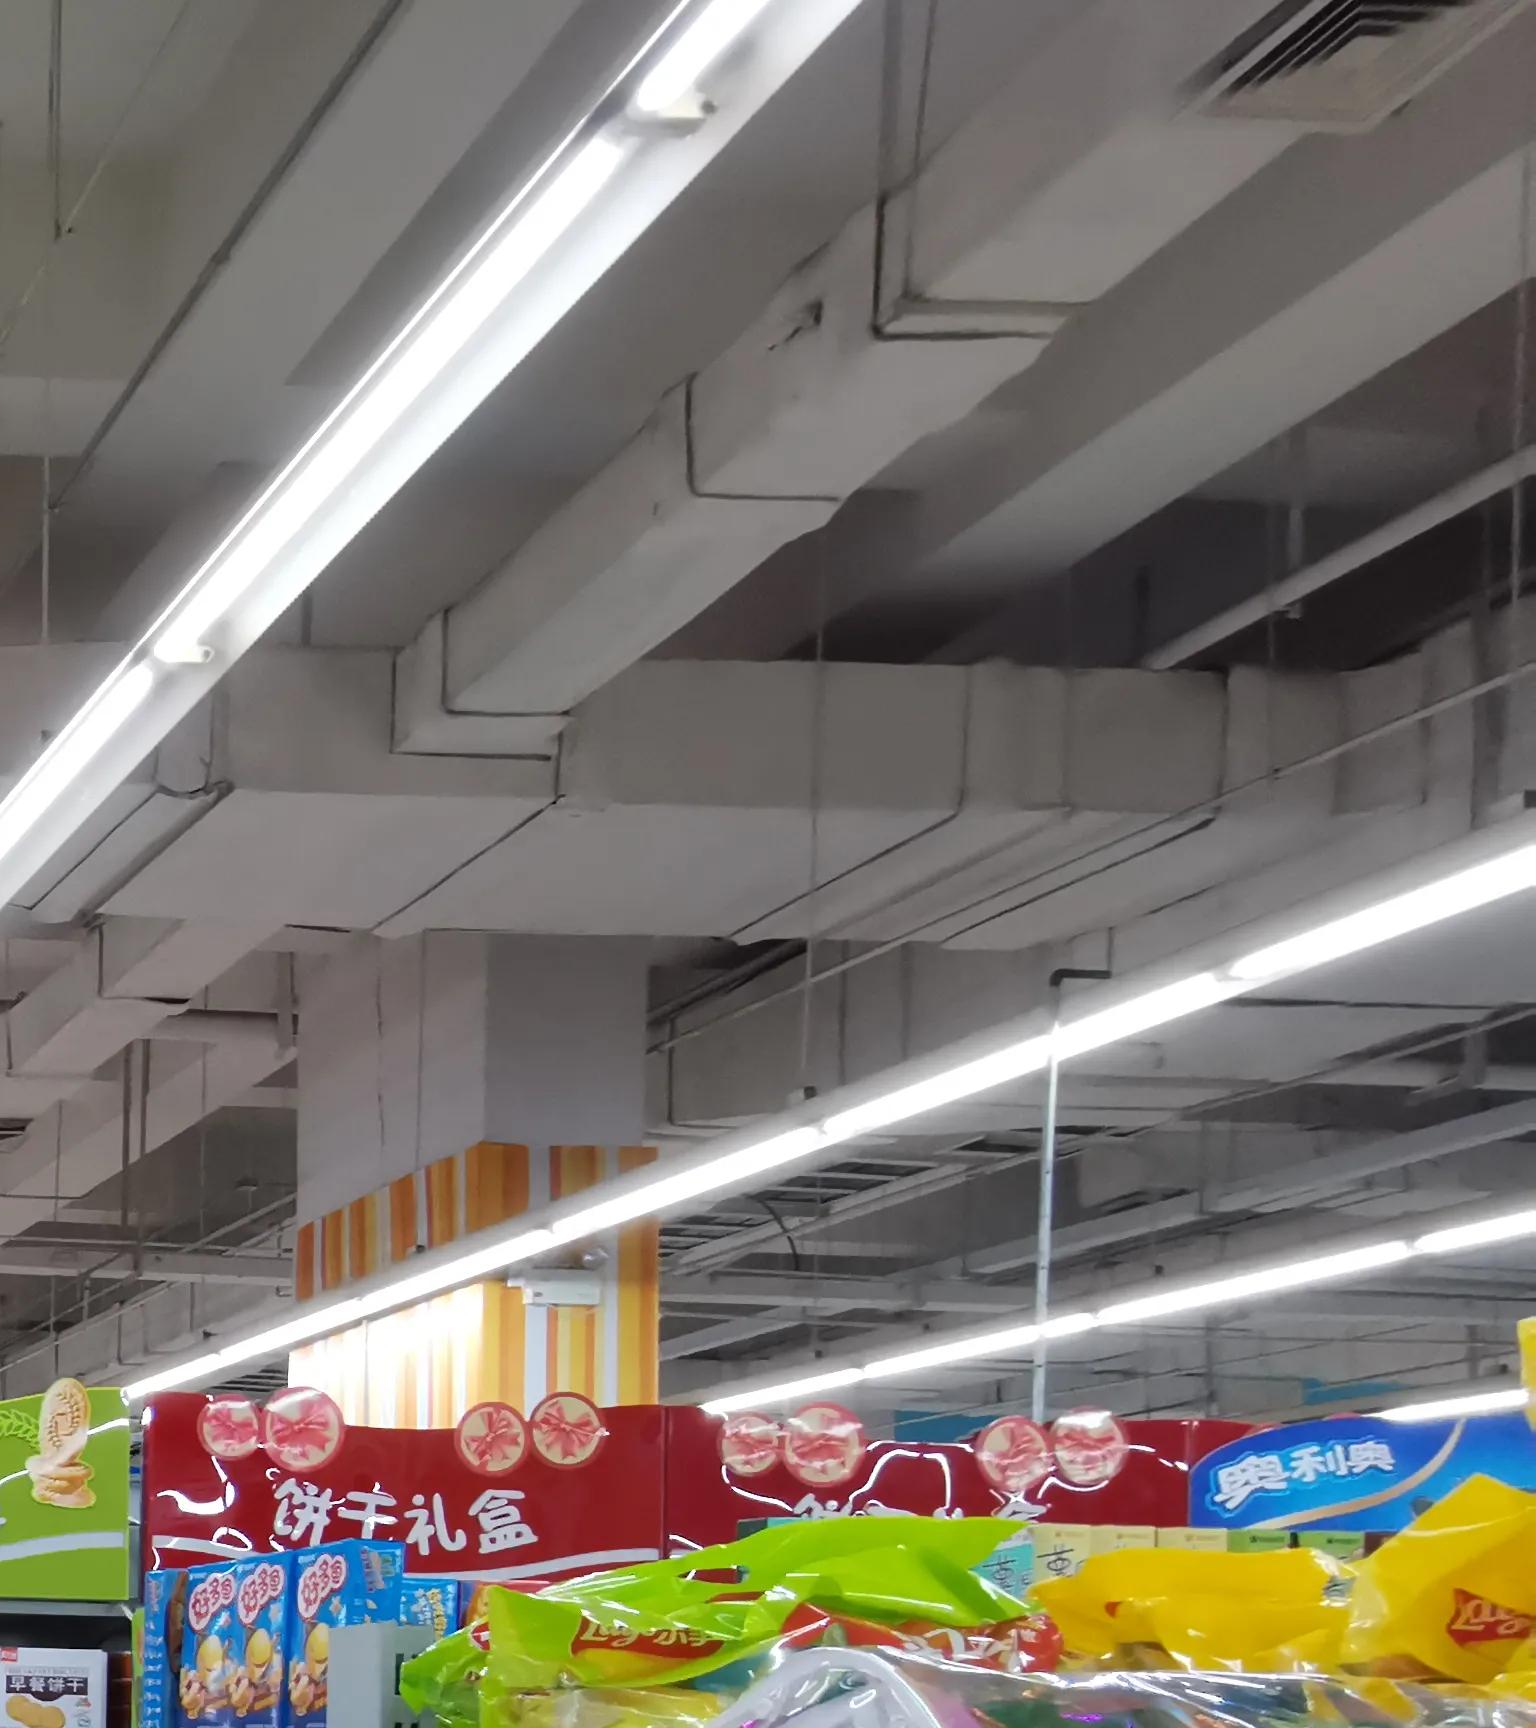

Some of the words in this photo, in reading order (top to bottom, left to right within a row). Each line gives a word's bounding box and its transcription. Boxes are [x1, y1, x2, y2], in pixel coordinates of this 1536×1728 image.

[1215, 1440, 1397, 1510] 奥利奥
[272, 1479, 538, 1557] 饼干礼盒
[190, 1575, 234, 1622] 好多鱼
[240, 1563, 283, 1617] 好多鱼
[299, 1554, 346, 1612] 好多鱼
[9, 1676, 84, 1692] 早餐饼干
